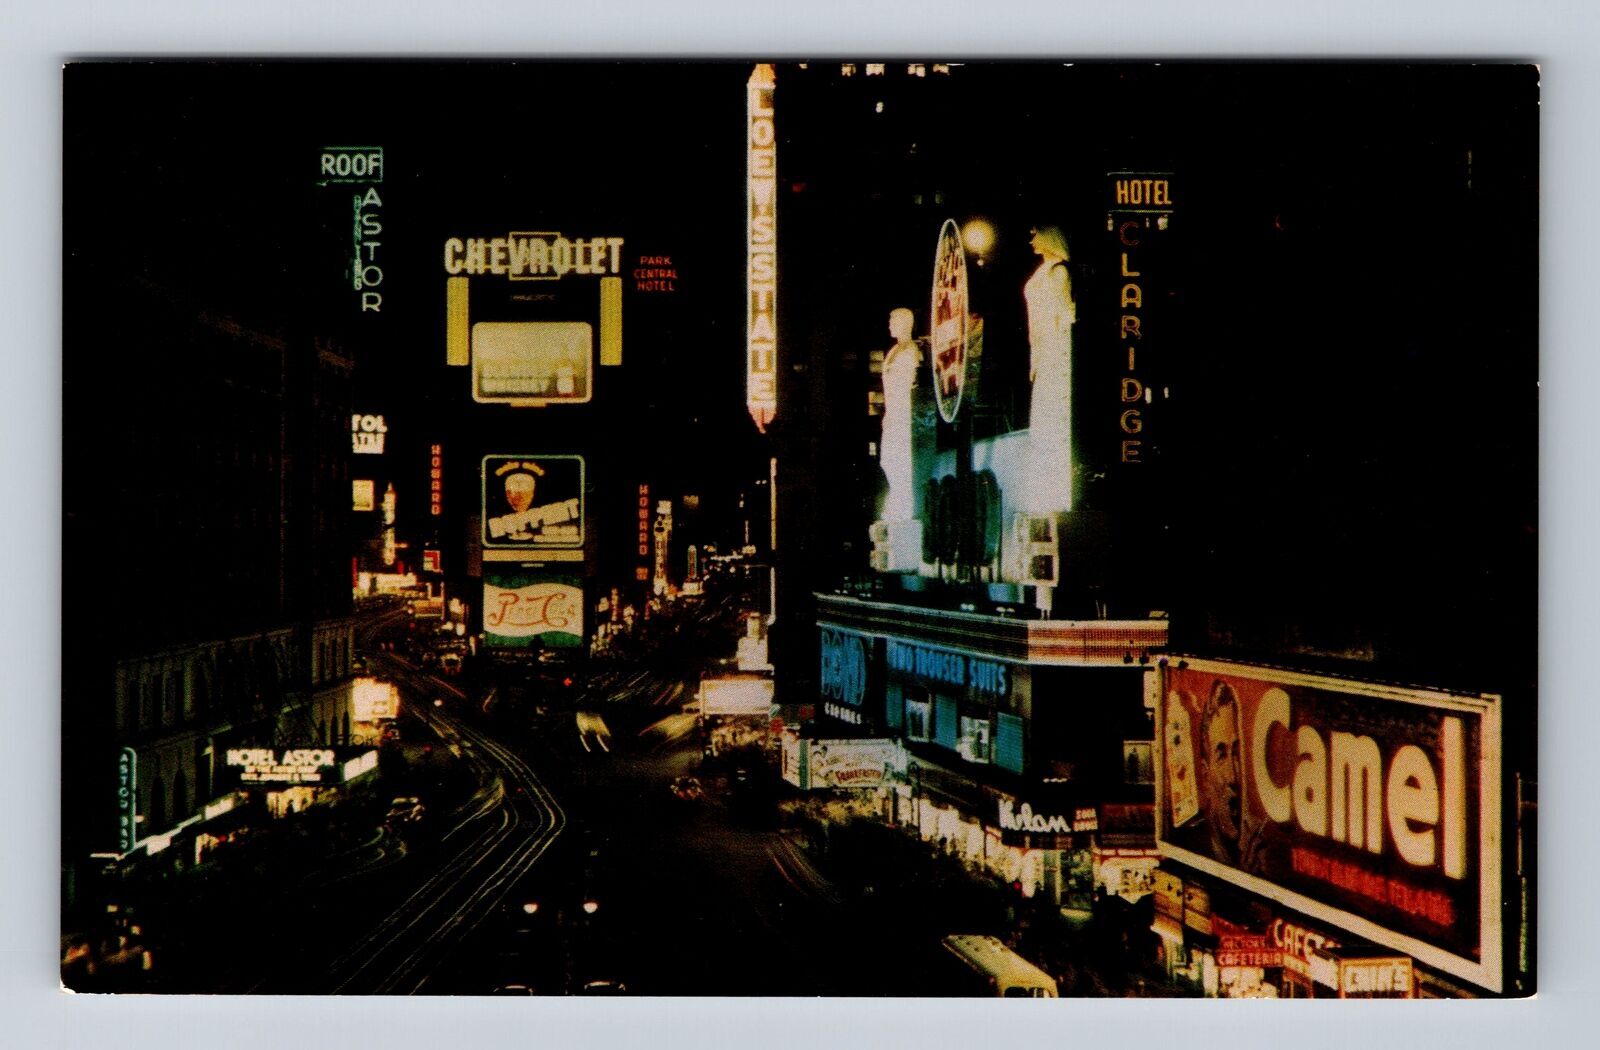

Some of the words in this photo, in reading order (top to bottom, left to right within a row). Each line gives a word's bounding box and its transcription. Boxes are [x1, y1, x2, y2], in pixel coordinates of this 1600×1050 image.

[321, 153, 381, 176] ROOF
[1116, 180, 1172, 206] HOTEL
[361, 187, 383, 312] ASTOR
[444, 237, 624, 275] CHEVROLET
[640, 256, 672, 266] PARK
[633, 268, 678, 279] CENTRAL
[637, 281, 674, 292] HOTEL
[1119, 222, 1143, 464] CLARIDGE
[969, 658, 1007, 697] SUITS
[283, 749, 335, 766] ASTOR
[1252, 686, 1468, 881] Camel
[1218, 952, 1284, 966] CAFETERIA
